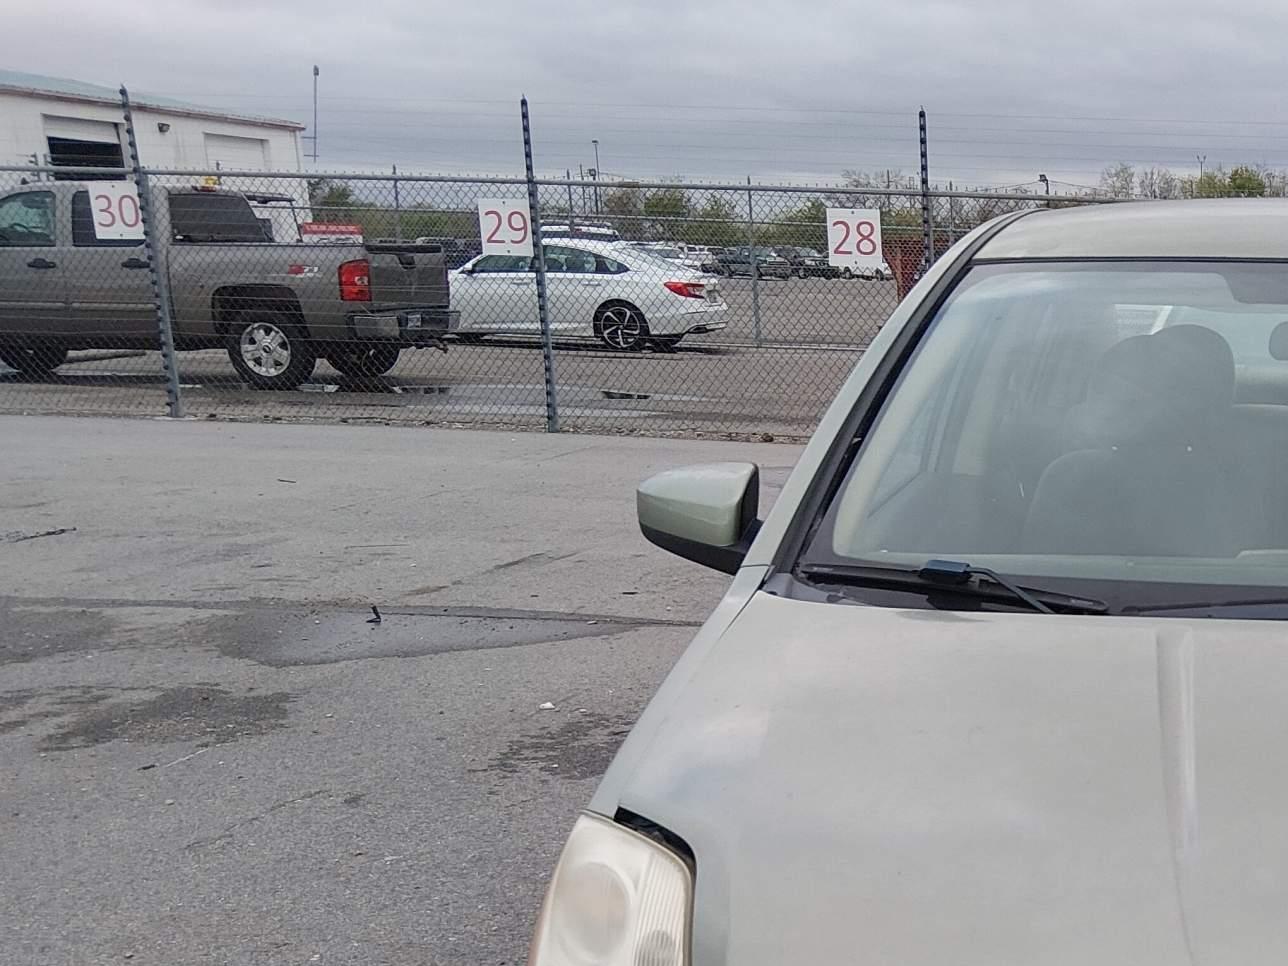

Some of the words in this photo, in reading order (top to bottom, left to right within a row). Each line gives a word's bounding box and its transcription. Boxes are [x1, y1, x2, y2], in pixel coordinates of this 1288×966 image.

[95, 194, 140, 228] 30
[484, 210, 528, 245] 29
[832, 220, 877, 256] 28
